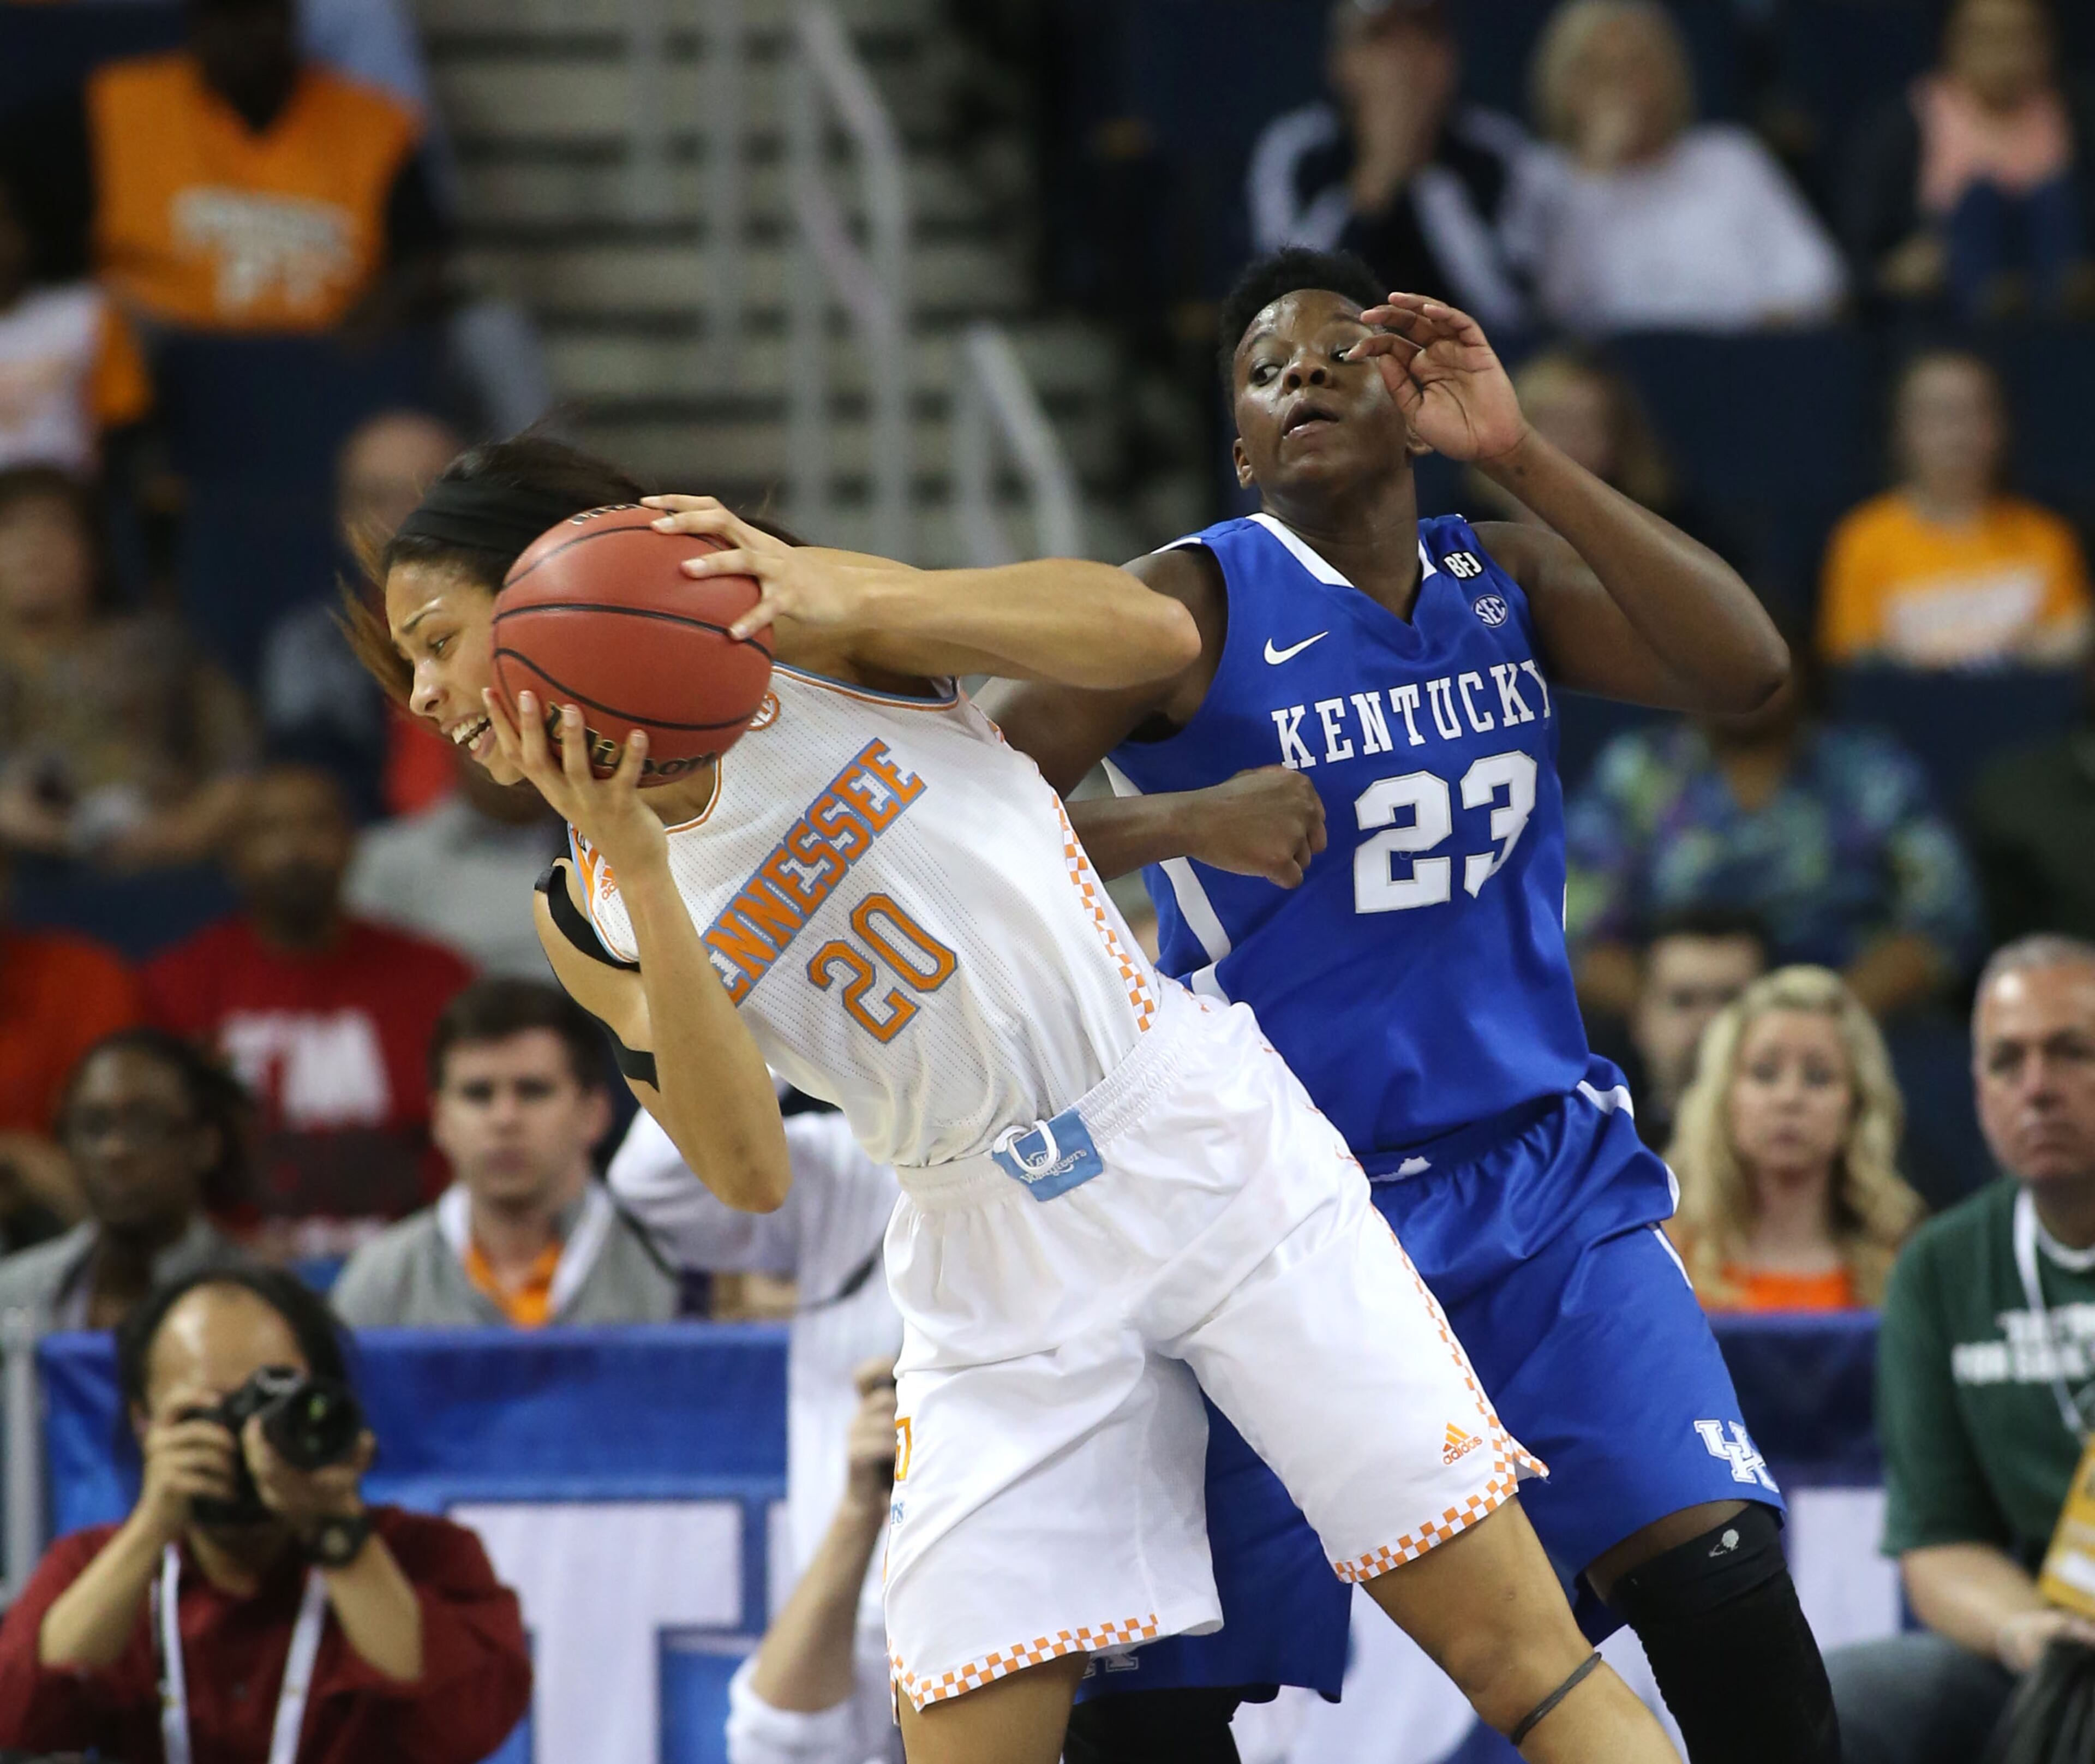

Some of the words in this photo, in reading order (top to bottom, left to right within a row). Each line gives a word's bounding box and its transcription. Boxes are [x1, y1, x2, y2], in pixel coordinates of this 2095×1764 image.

[1444, 552, 1482, 578] BFJ
[1475, 596, 1506, 624] SEC
[1271, 659, 1551, 770] KENTUCKY
[1353, 750, 1538, 914] 23
[806, 893, 958, 1044] 20
[1443, 1436, 1483, 1465] adidas
